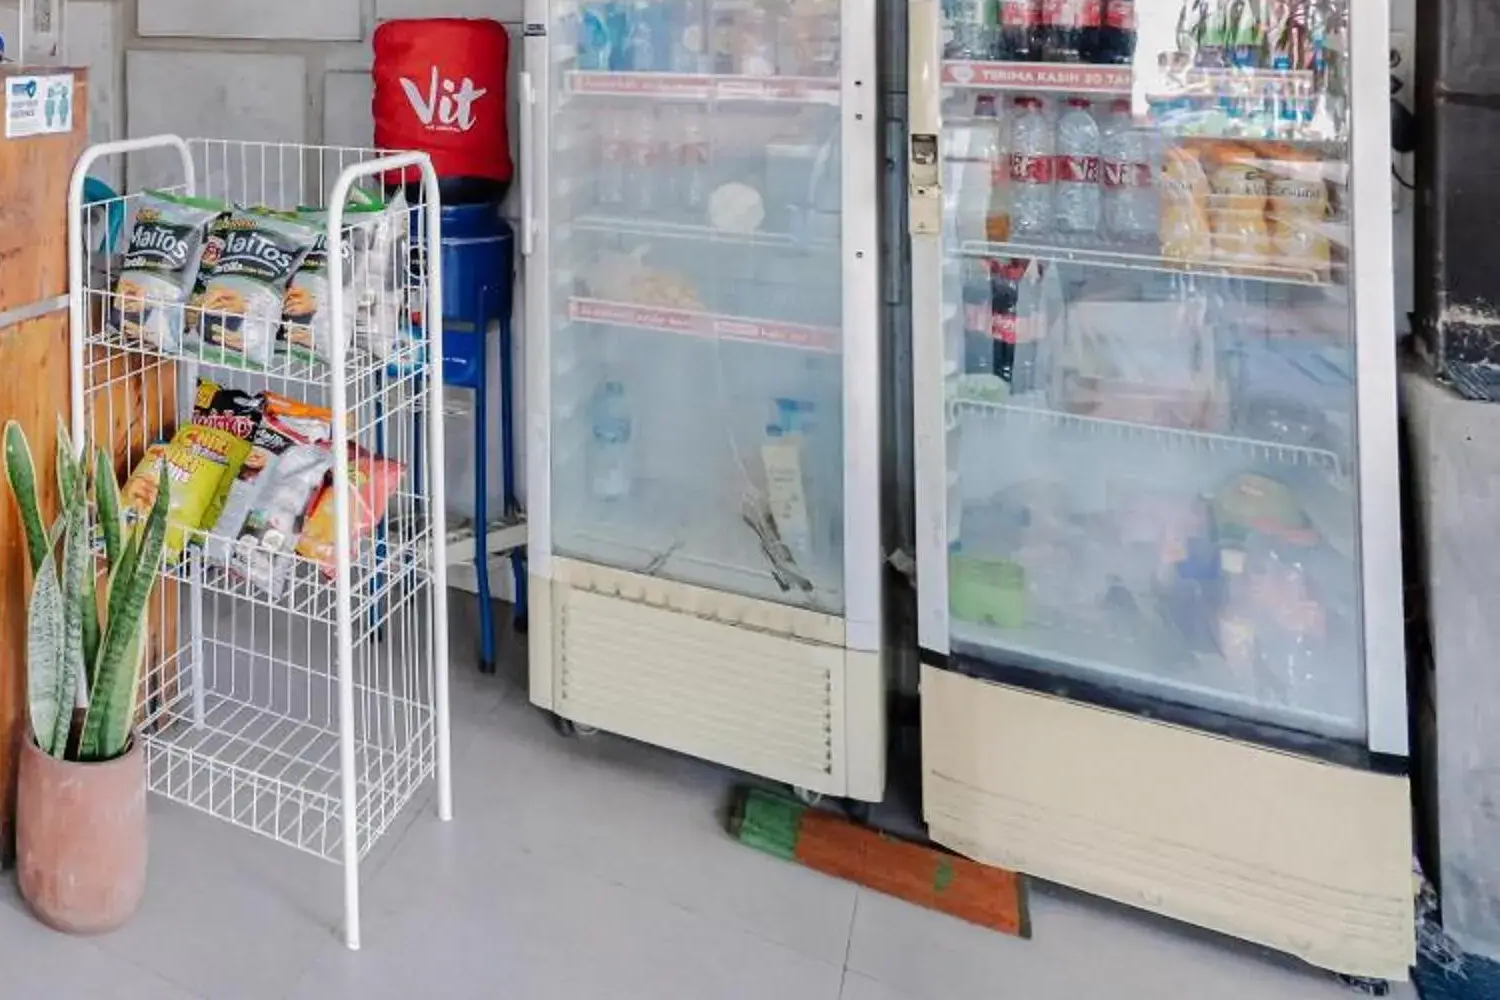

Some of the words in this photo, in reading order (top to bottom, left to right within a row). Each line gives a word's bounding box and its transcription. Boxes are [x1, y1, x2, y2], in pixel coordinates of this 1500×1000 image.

[981, 68, 1034, 83] TERIMA
[1036, 71, 1079, 84] KASIH
[399, 65, 487, 131] Vit
